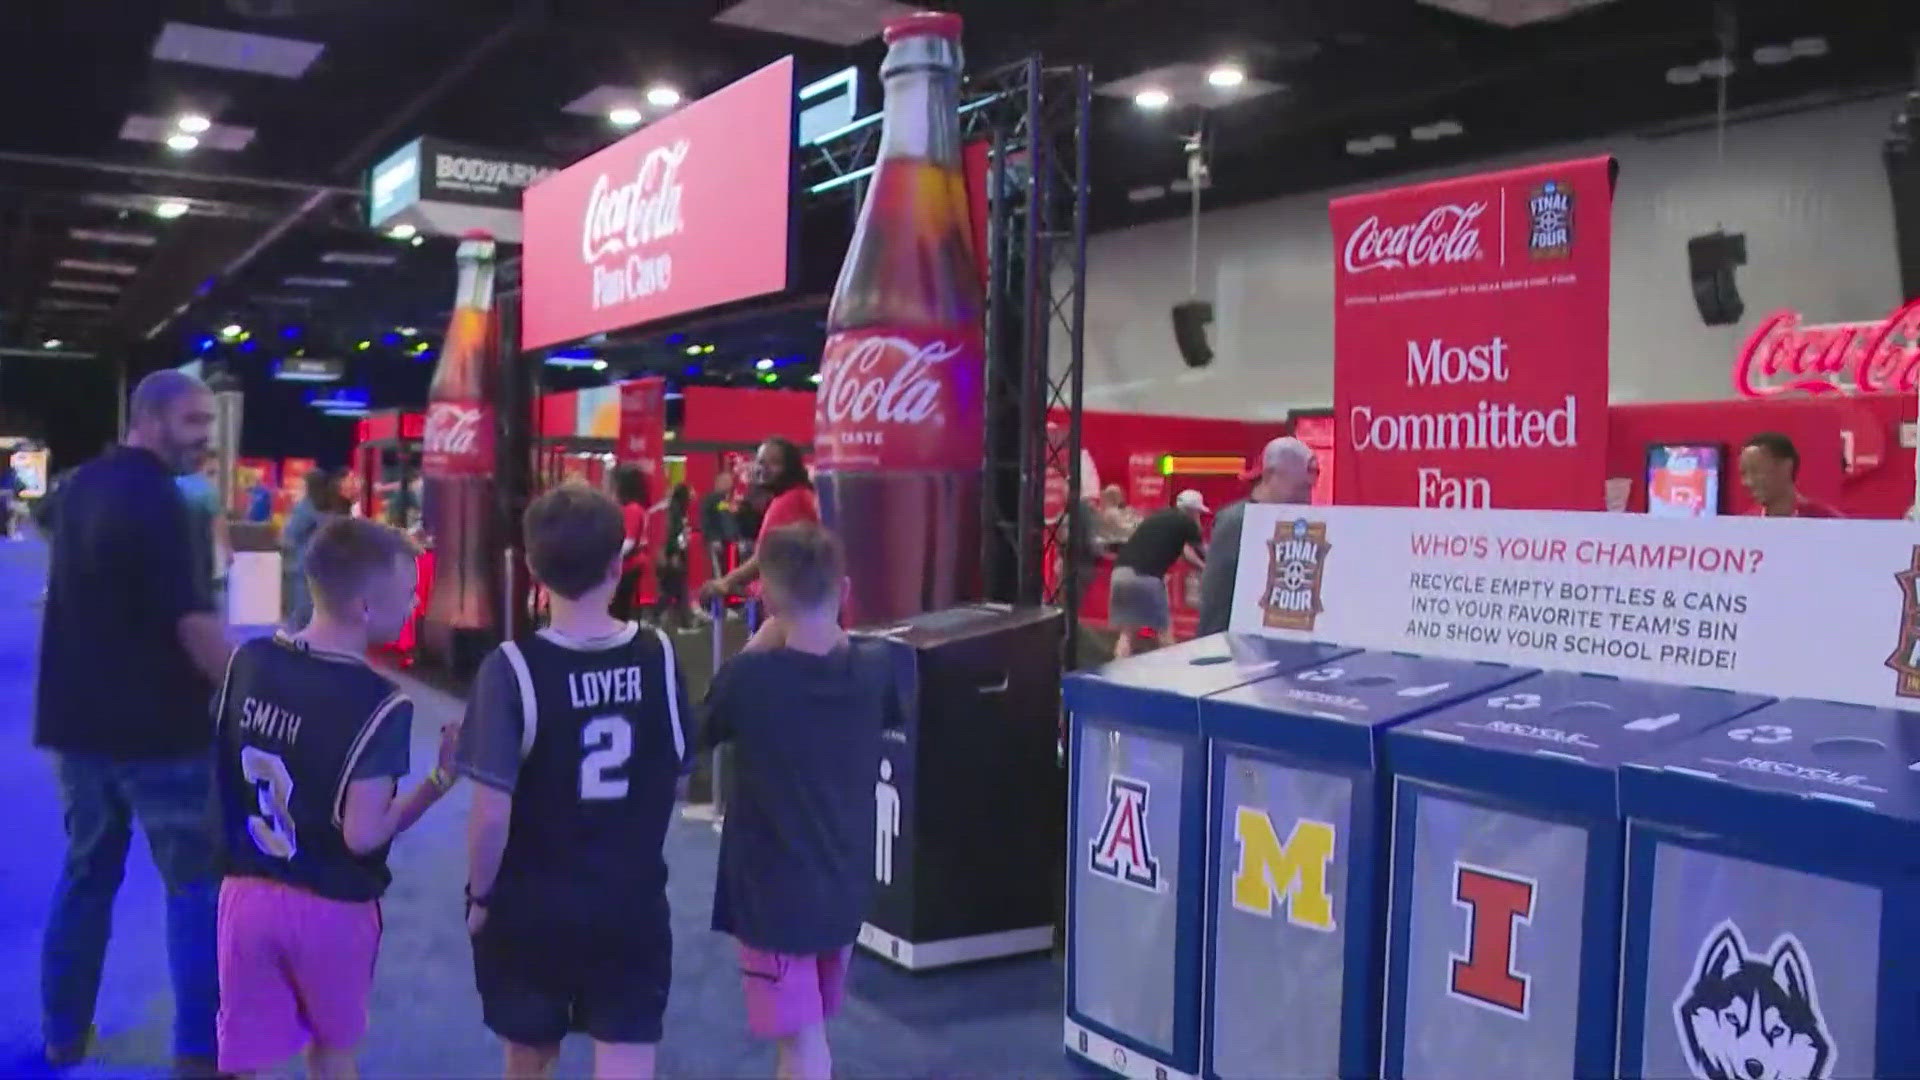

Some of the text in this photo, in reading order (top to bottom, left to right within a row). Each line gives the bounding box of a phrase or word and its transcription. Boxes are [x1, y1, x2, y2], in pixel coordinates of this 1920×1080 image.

[436, 154, 558, 187] BODYARM
[1530, 193, 1568, 216] FINAL
[1344, 201, 1488, 273] Coca-Cola
[1531, 228, 1568, 247] FOUR
[1407, 336, 1509, 387] Most
[1350, 395, 1577, 451] Committed
[1417, 467, 1491, 509] Fan
[1275, 540, 1318, 564] FINAL
[1411, 533, 1764, 574] WHO'S YOUR CHAMPION?
[1269, 587, 1312, 611] FOUR
[1410, 572, 1748, 614] RECYCLE EMPTY BOTTLES & CANS
[1411, 597, 1738, 642] INTO YOUR FAVORITE TEAM'S BIN
[1406, 619, 1738, 671] AND SHOW YOUR SCHOOL PRIDE!
[568, 665, 643, 709] LOYER
[239, 695, 303, 746] SMITH
[579, 714, 633, 800] 2
[241, 745, 298, 862] 3
[1089, 774, 1160, 893] A
[1232, 805, 1335, 932] M
[1447, 860, 1538, 1021] I
